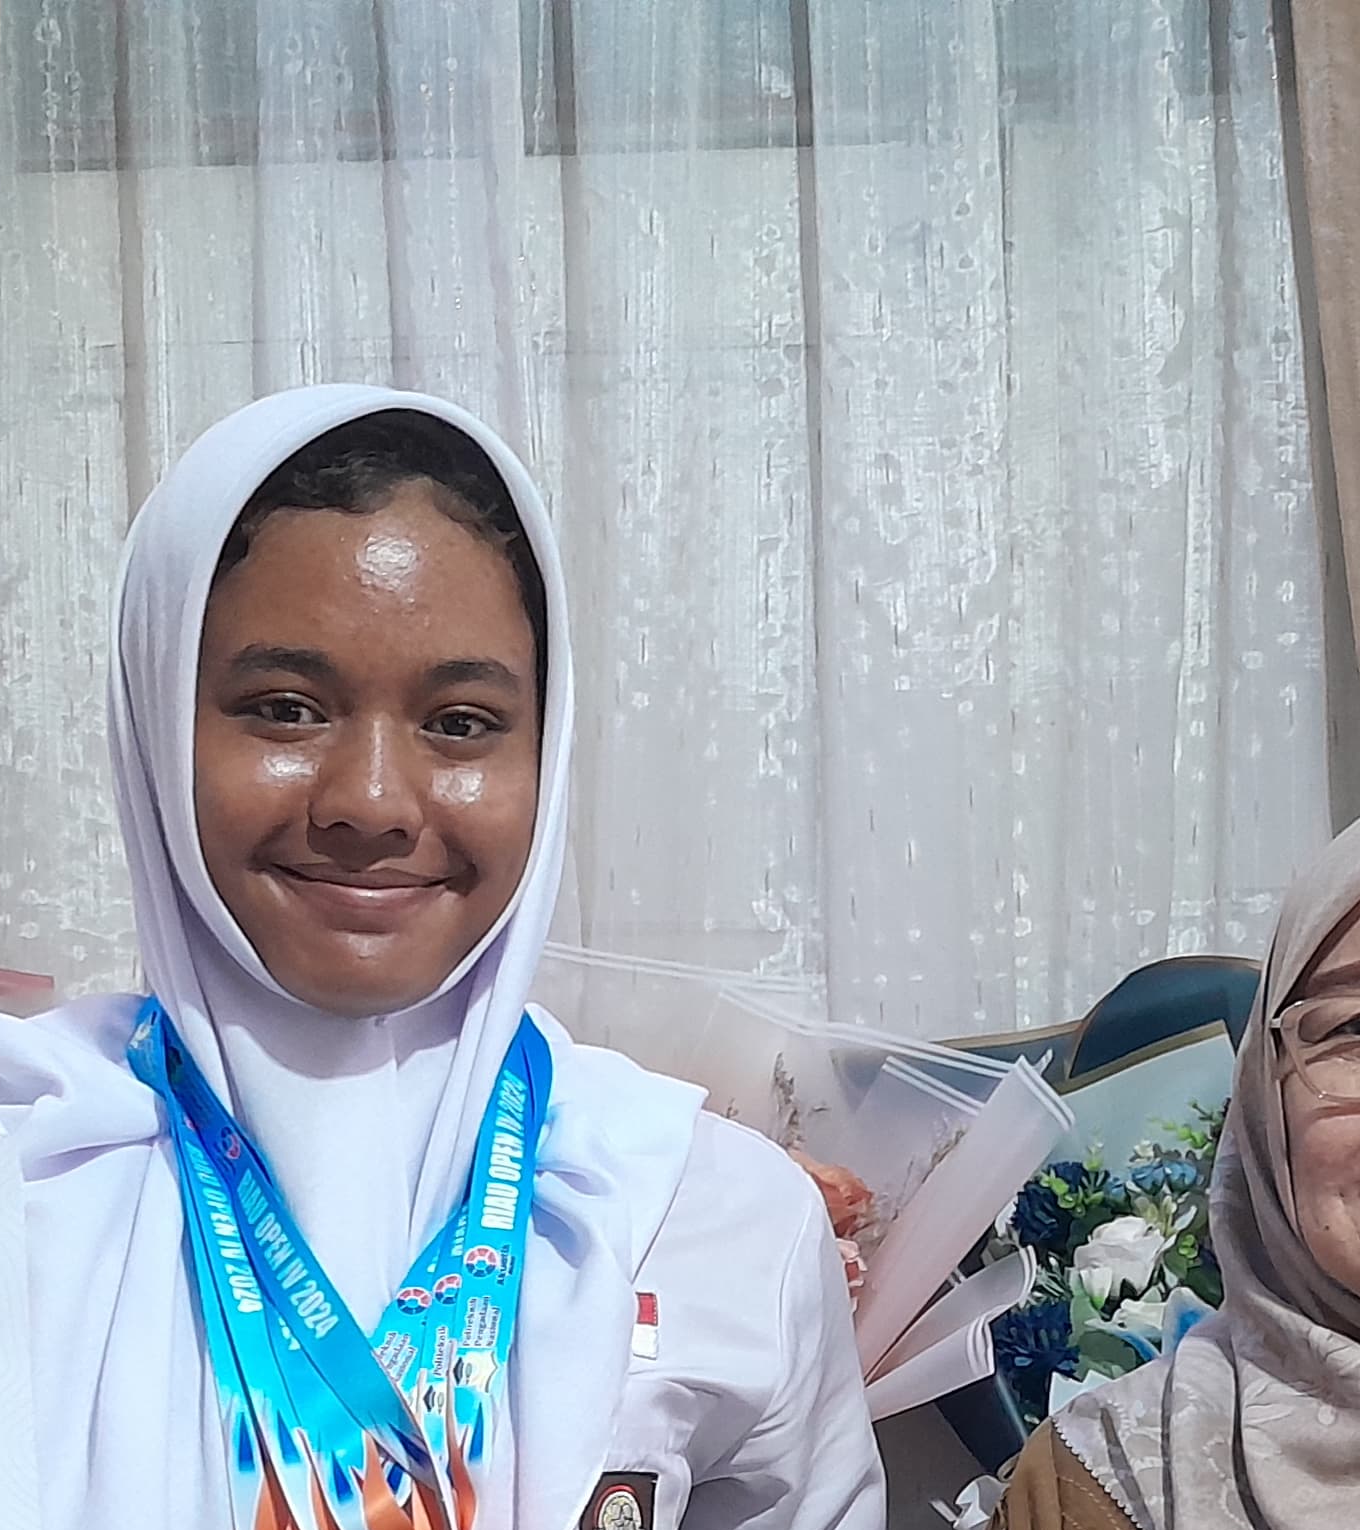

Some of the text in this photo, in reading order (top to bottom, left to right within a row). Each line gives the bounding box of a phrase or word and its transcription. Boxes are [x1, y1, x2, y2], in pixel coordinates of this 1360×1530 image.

[489, 1131, 525, 1182] OPEN
[203, 1184, 238, 1237] OPEN
[237, 1168, 263, 1225] RIAU
[481, 1182, 520, 1230] RIAU
[218, 1237, 248, 1260] IV
[254, 1212, 295, 1272] OPEN
[224, 1258, 264, 1313] 2024
[276, 1263, 309, 1291] IV
[291, 1279, 340, 1339] 2024
